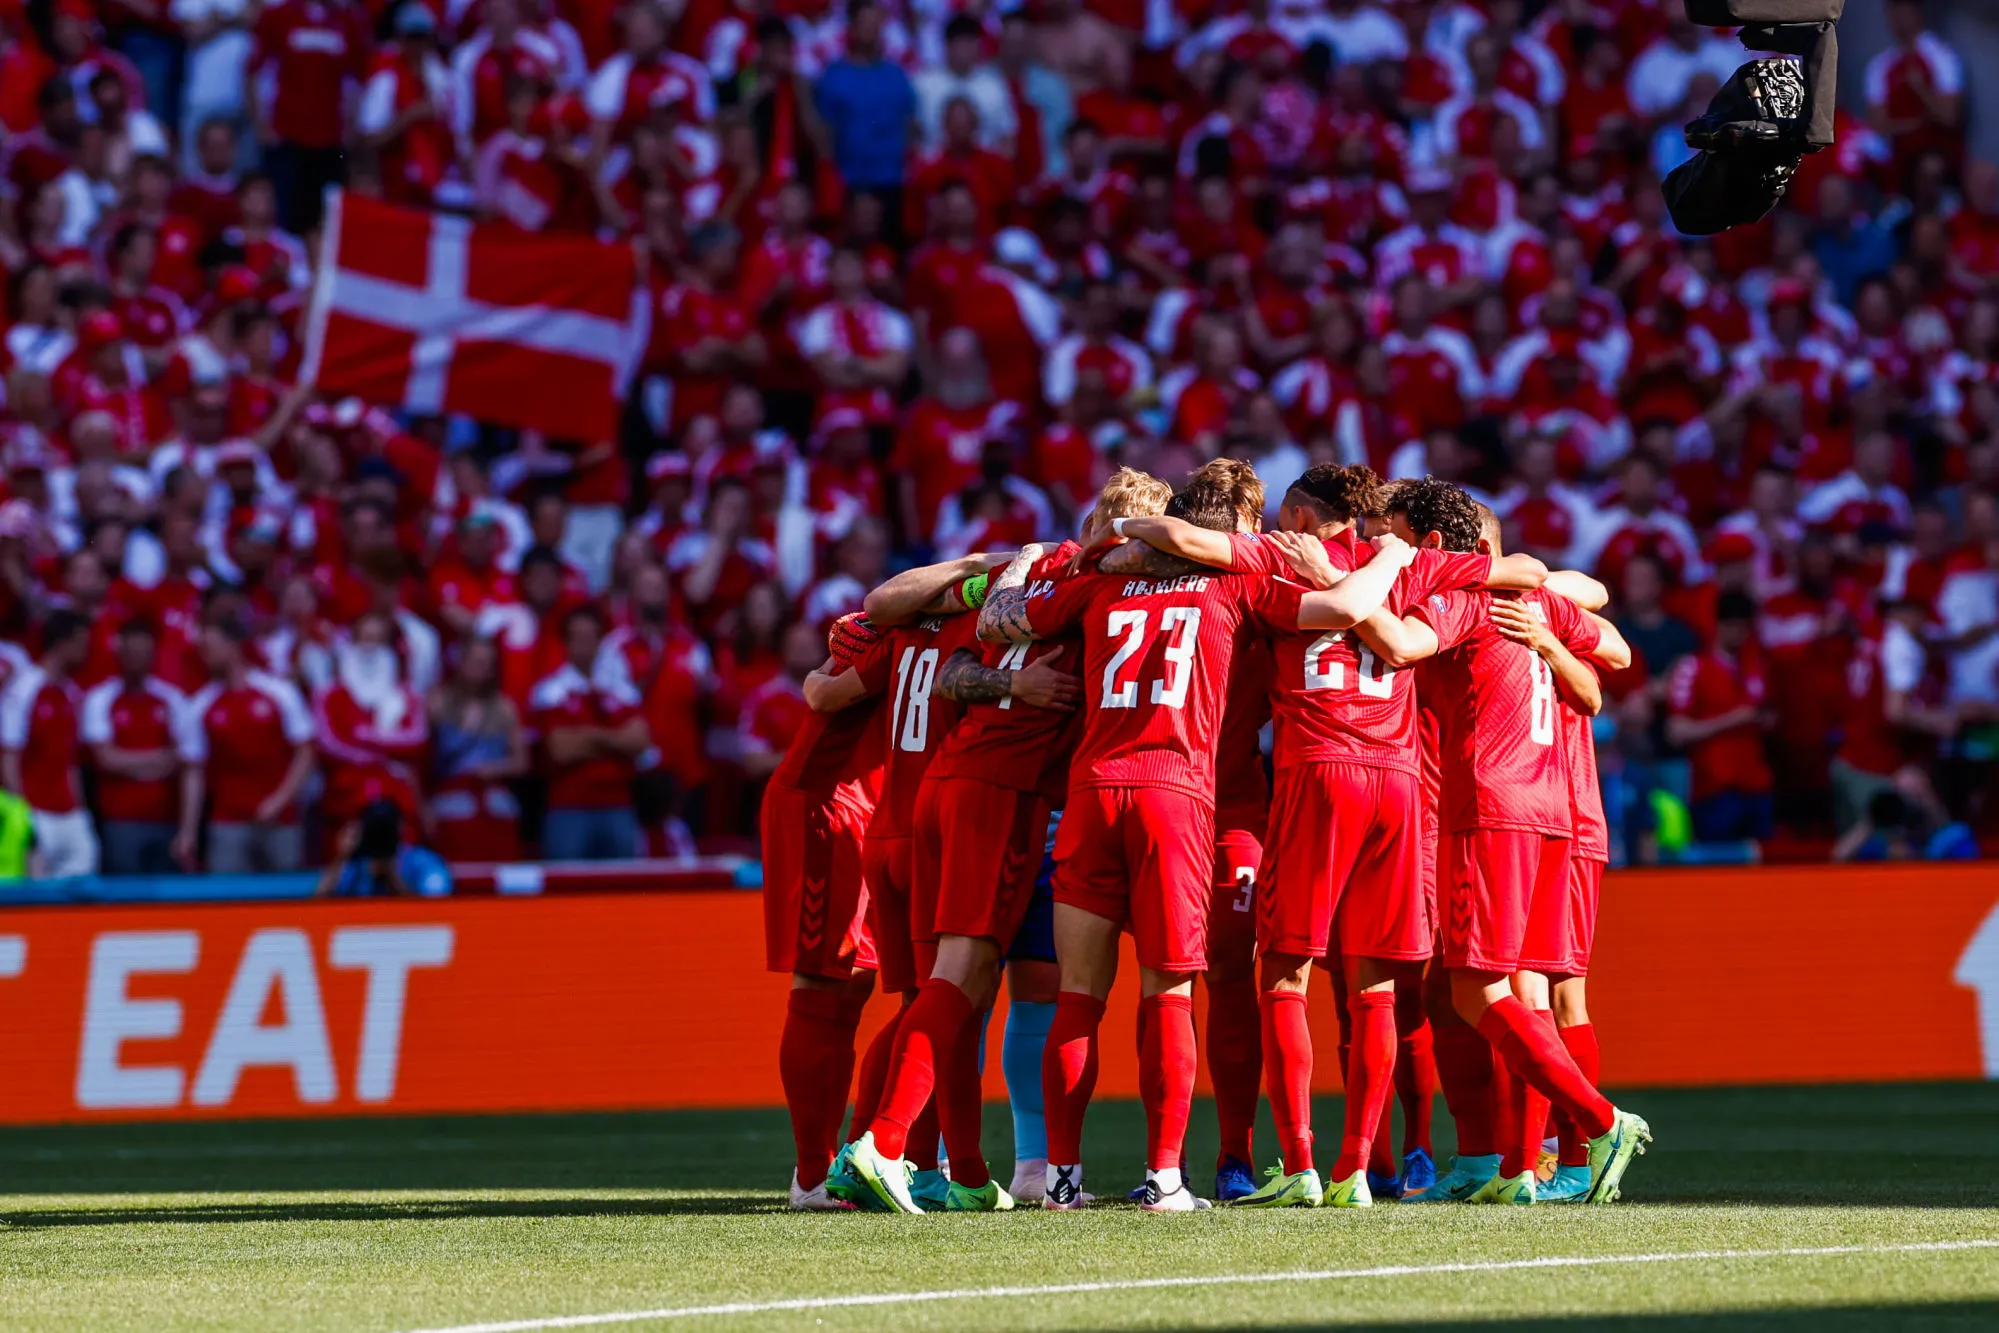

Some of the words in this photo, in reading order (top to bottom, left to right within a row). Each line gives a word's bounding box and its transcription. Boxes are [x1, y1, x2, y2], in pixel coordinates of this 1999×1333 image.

[892, 646, 940, 752] 18
[1100, 606, 1202, 710] 23
[1528, 649, 1554, 746] 8
[1232, 866, 1255, 912] 3
[77, 926, 455, 1108] EAT
